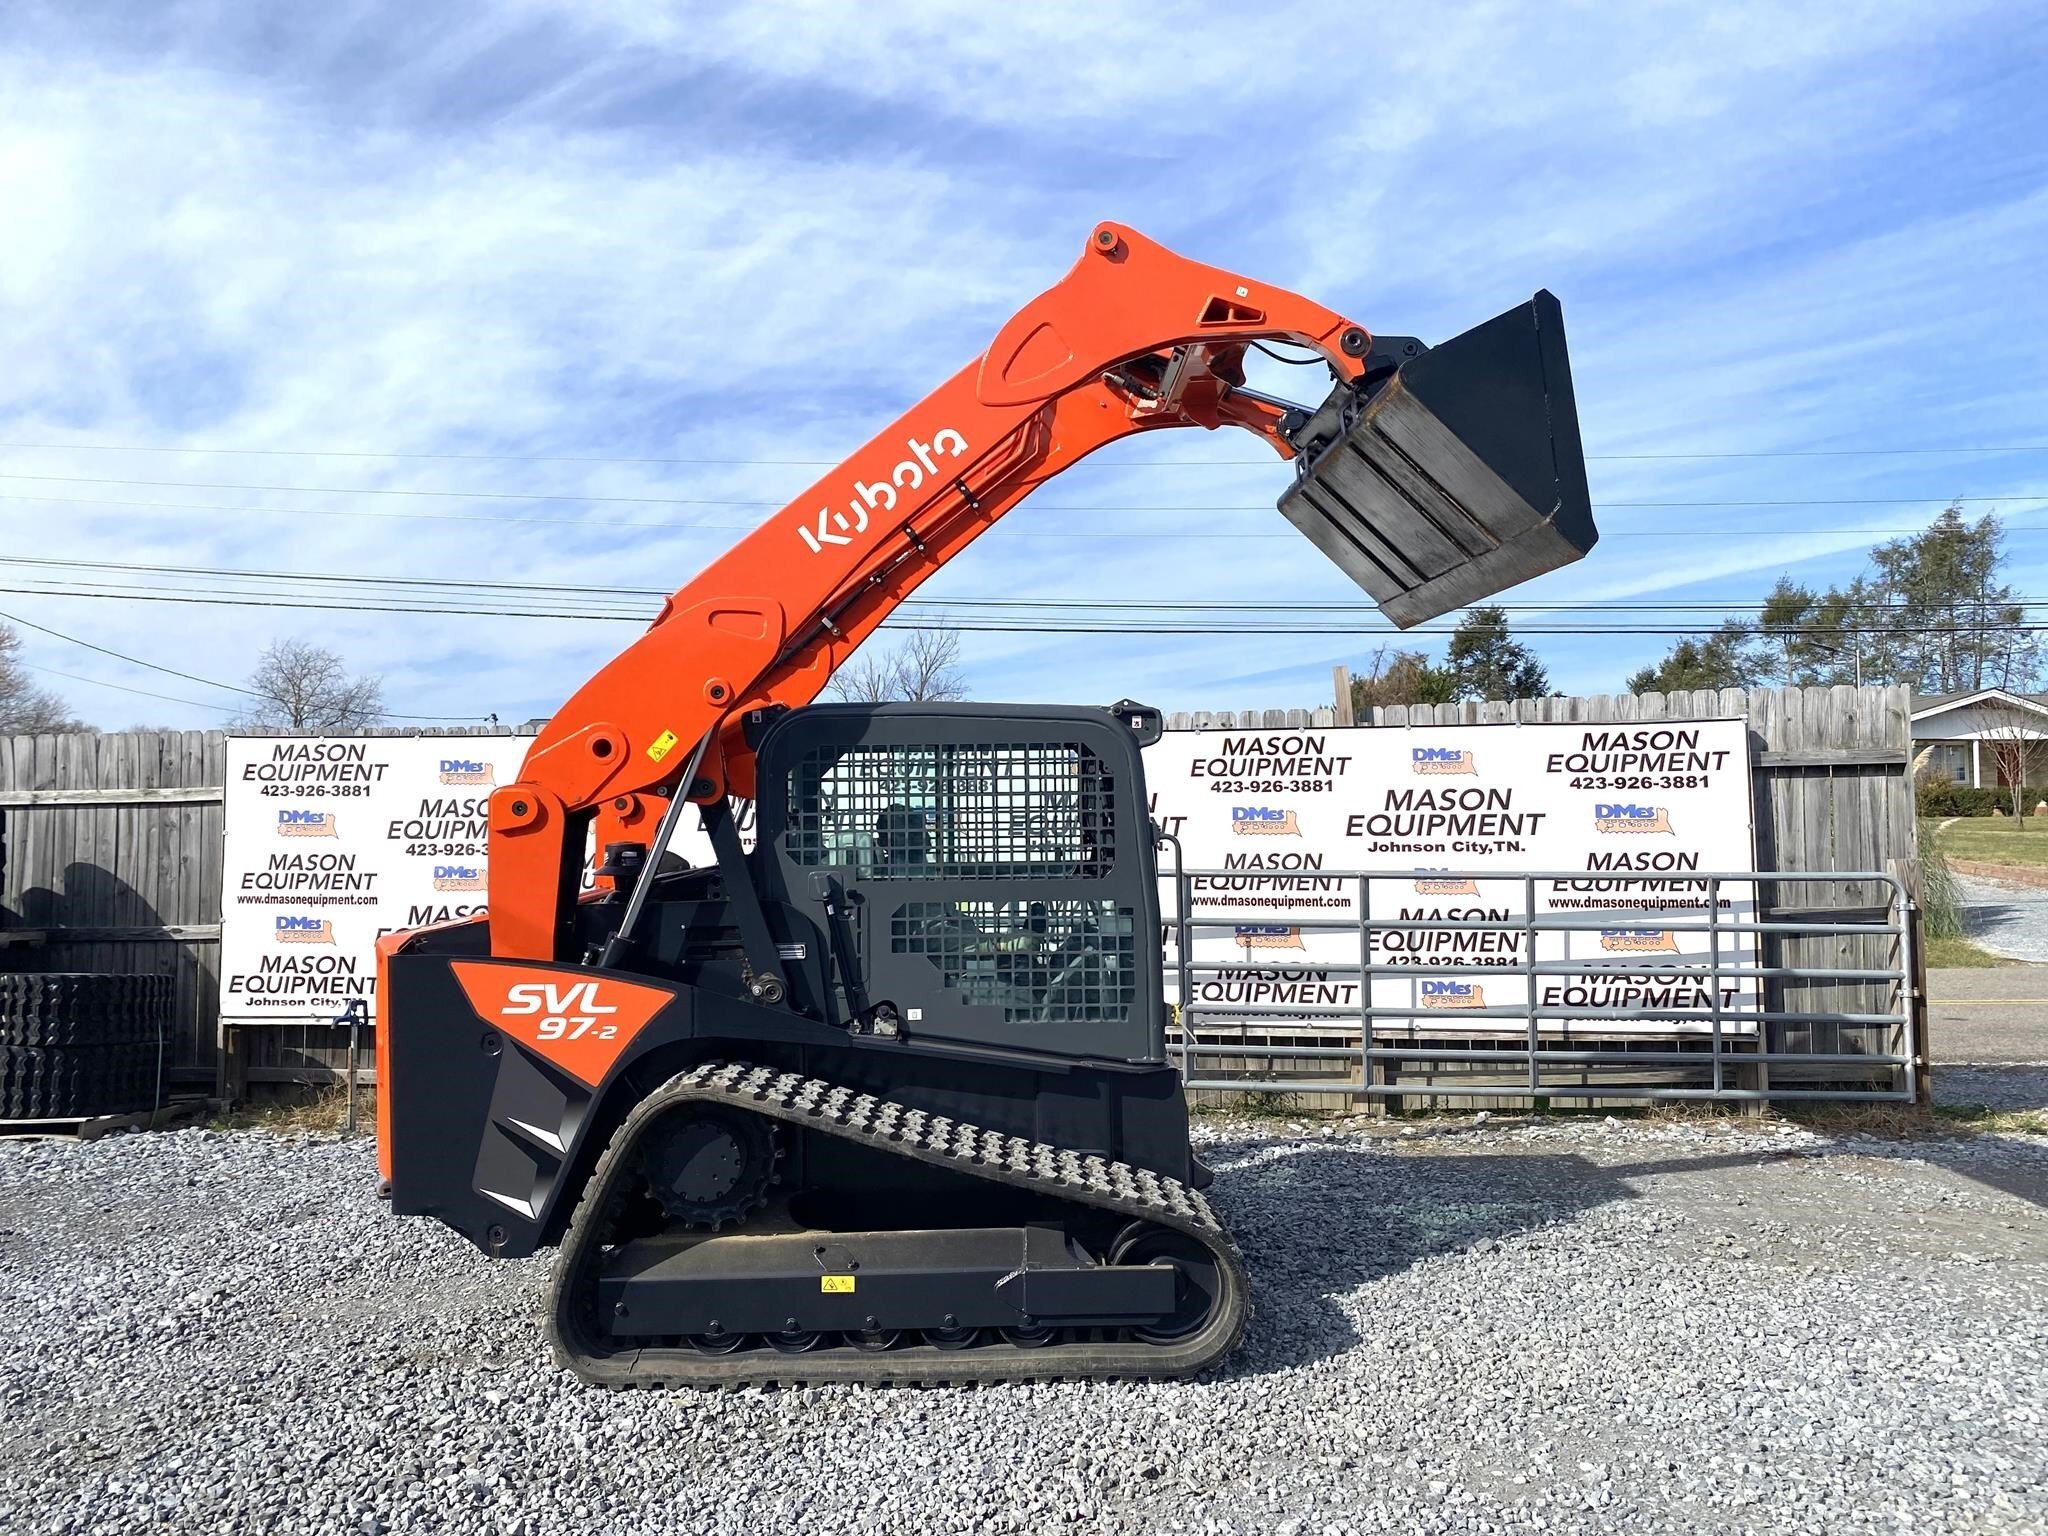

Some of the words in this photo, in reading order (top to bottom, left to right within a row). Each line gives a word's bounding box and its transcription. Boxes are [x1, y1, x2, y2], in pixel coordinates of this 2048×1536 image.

[797, 428, 968, 554] Kubota
[1222, 736, 1326, 756] MASON
[1582, 730, 1700, 751] MASON
[272, 743, 366, 762] MASON
[1546, 750, 1730, 773] EQUIPMENT
[242, 763, 389, 782] EQUIPMENT
[1190, 757, 1352, 777] EQUIPMENT
[260, 785, 370, 797] 423-926-3881
[1210, 779, 1333, 793] 423-926-3881
[1570, 775, 1709, 790] 423-926-3881
[419, 799, 488, 818] MASO
[1384, 788, 1512, 811] MASON
[387, 820, 488, 840] EQUIPM
[1345, 813, 1546, 837] EQUIPMENT
[405, 843, 488, 856] 423-926-3
[1367, 841, 1446, 853] Johnson
[1452, 840, 1526, 855] City,TN.
[268, 853, 356, 871] MASON
[1224, 853, 1323, 870] MASON
[1587, 852, 1699, 871] MASON
[241, 872, 378, 890] EQUIPMENT
[1553, 879, 1721, 892] EQUIPMEN
[237, 893, 378, 908] www.dmasonequipment.com
[1191, 895, 1351, 909] www.dmasonequipment.com
[1399, 908, 1510, 921] MASON
[259, 955, 357, 974] MASON
[228, 975, 377, 995] EQUIPMENT
[245, 997, 306, 1006] Johnson
[501, 982, 618, 1015] SVL
[1542, 987, 1741, 1009] EQUIPMENT
[536, 1016, 618, 1040] 97-2
